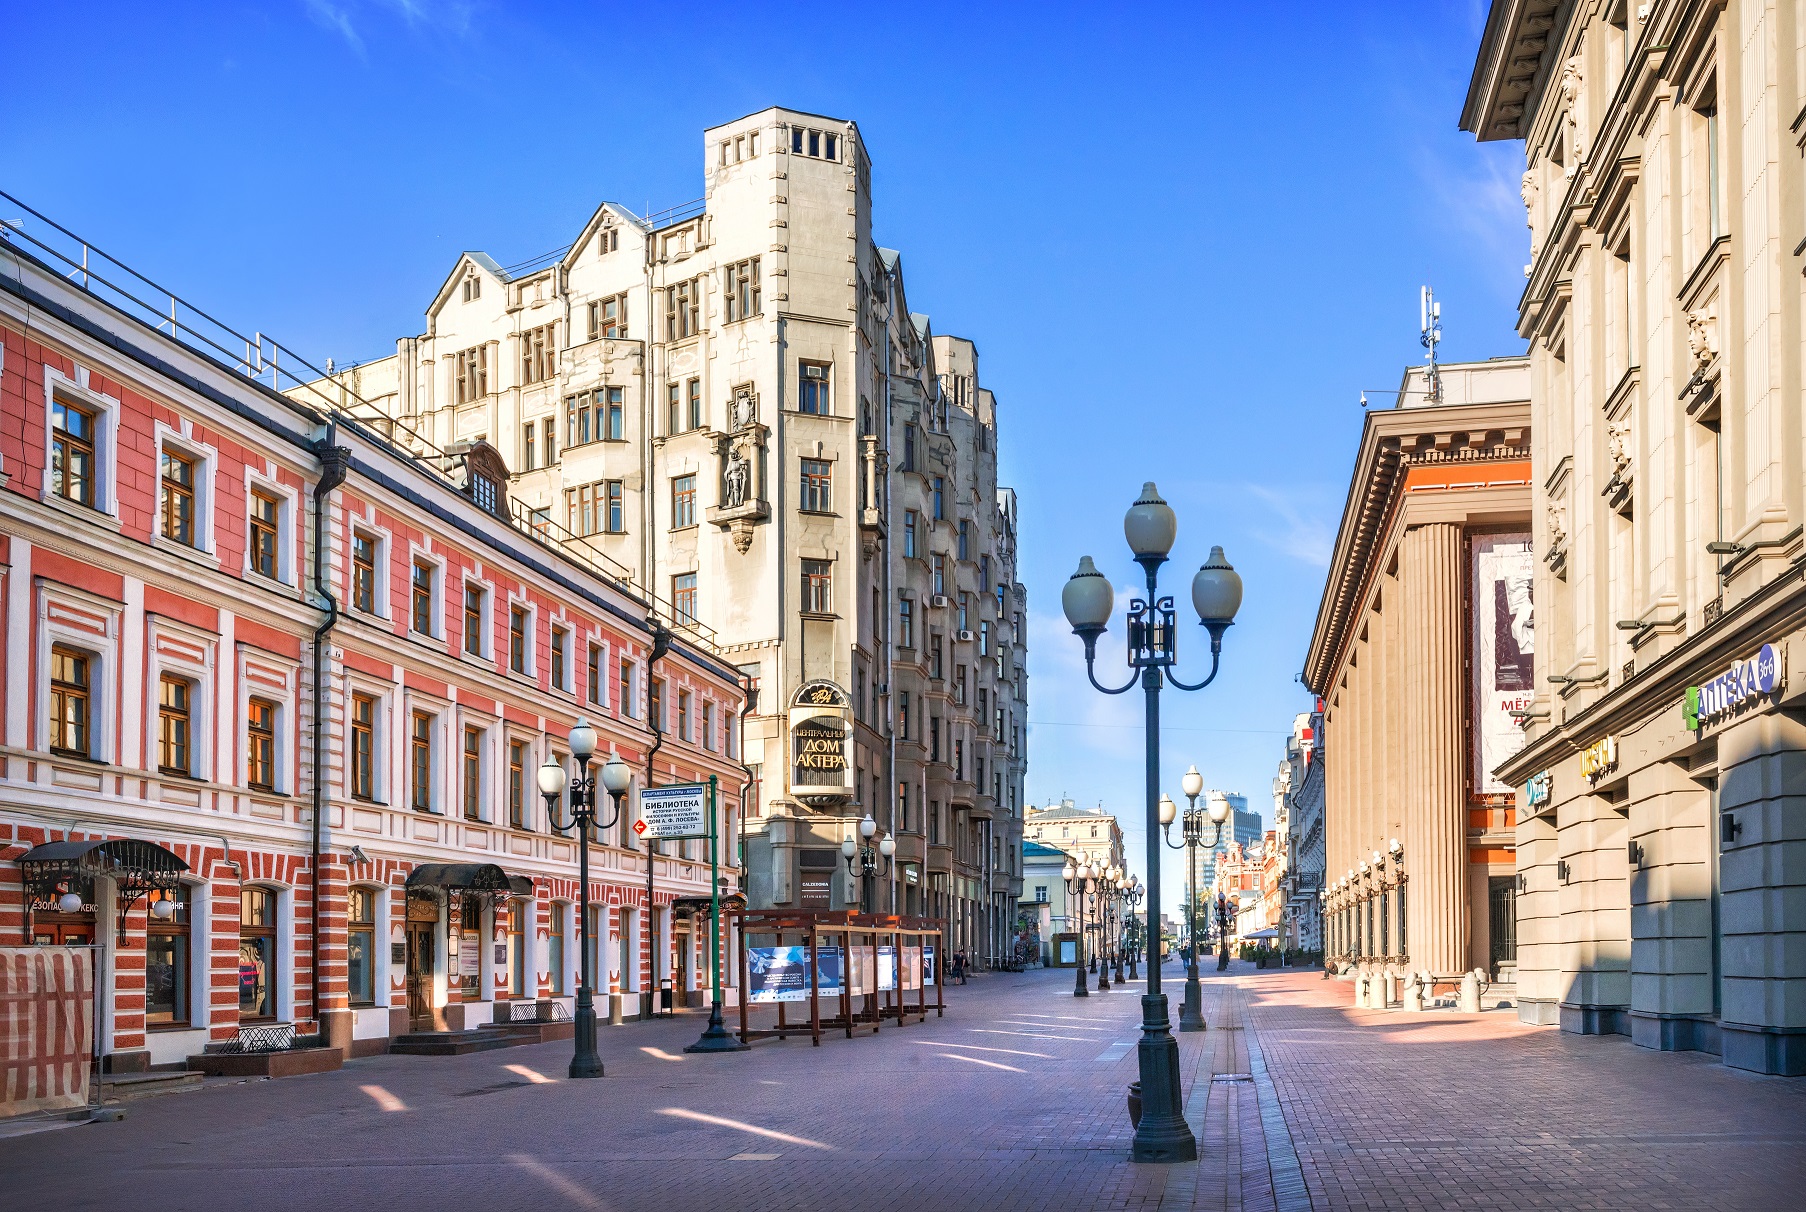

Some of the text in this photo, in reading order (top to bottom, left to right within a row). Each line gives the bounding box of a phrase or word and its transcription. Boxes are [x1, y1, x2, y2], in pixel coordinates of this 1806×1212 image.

[1697, 660, 1758, 720] АПТЕКА
[796, 729, 846, 738] ЦЕНТРАЛЬНЫЙ
[803, 739, 839, 753] ДОМ
[795, 754, 848, 768] АКТЕРА
[646, 800, 699, 809] БИБЛИОТЕКА
[82, 903, 100, 913] КЕКС
